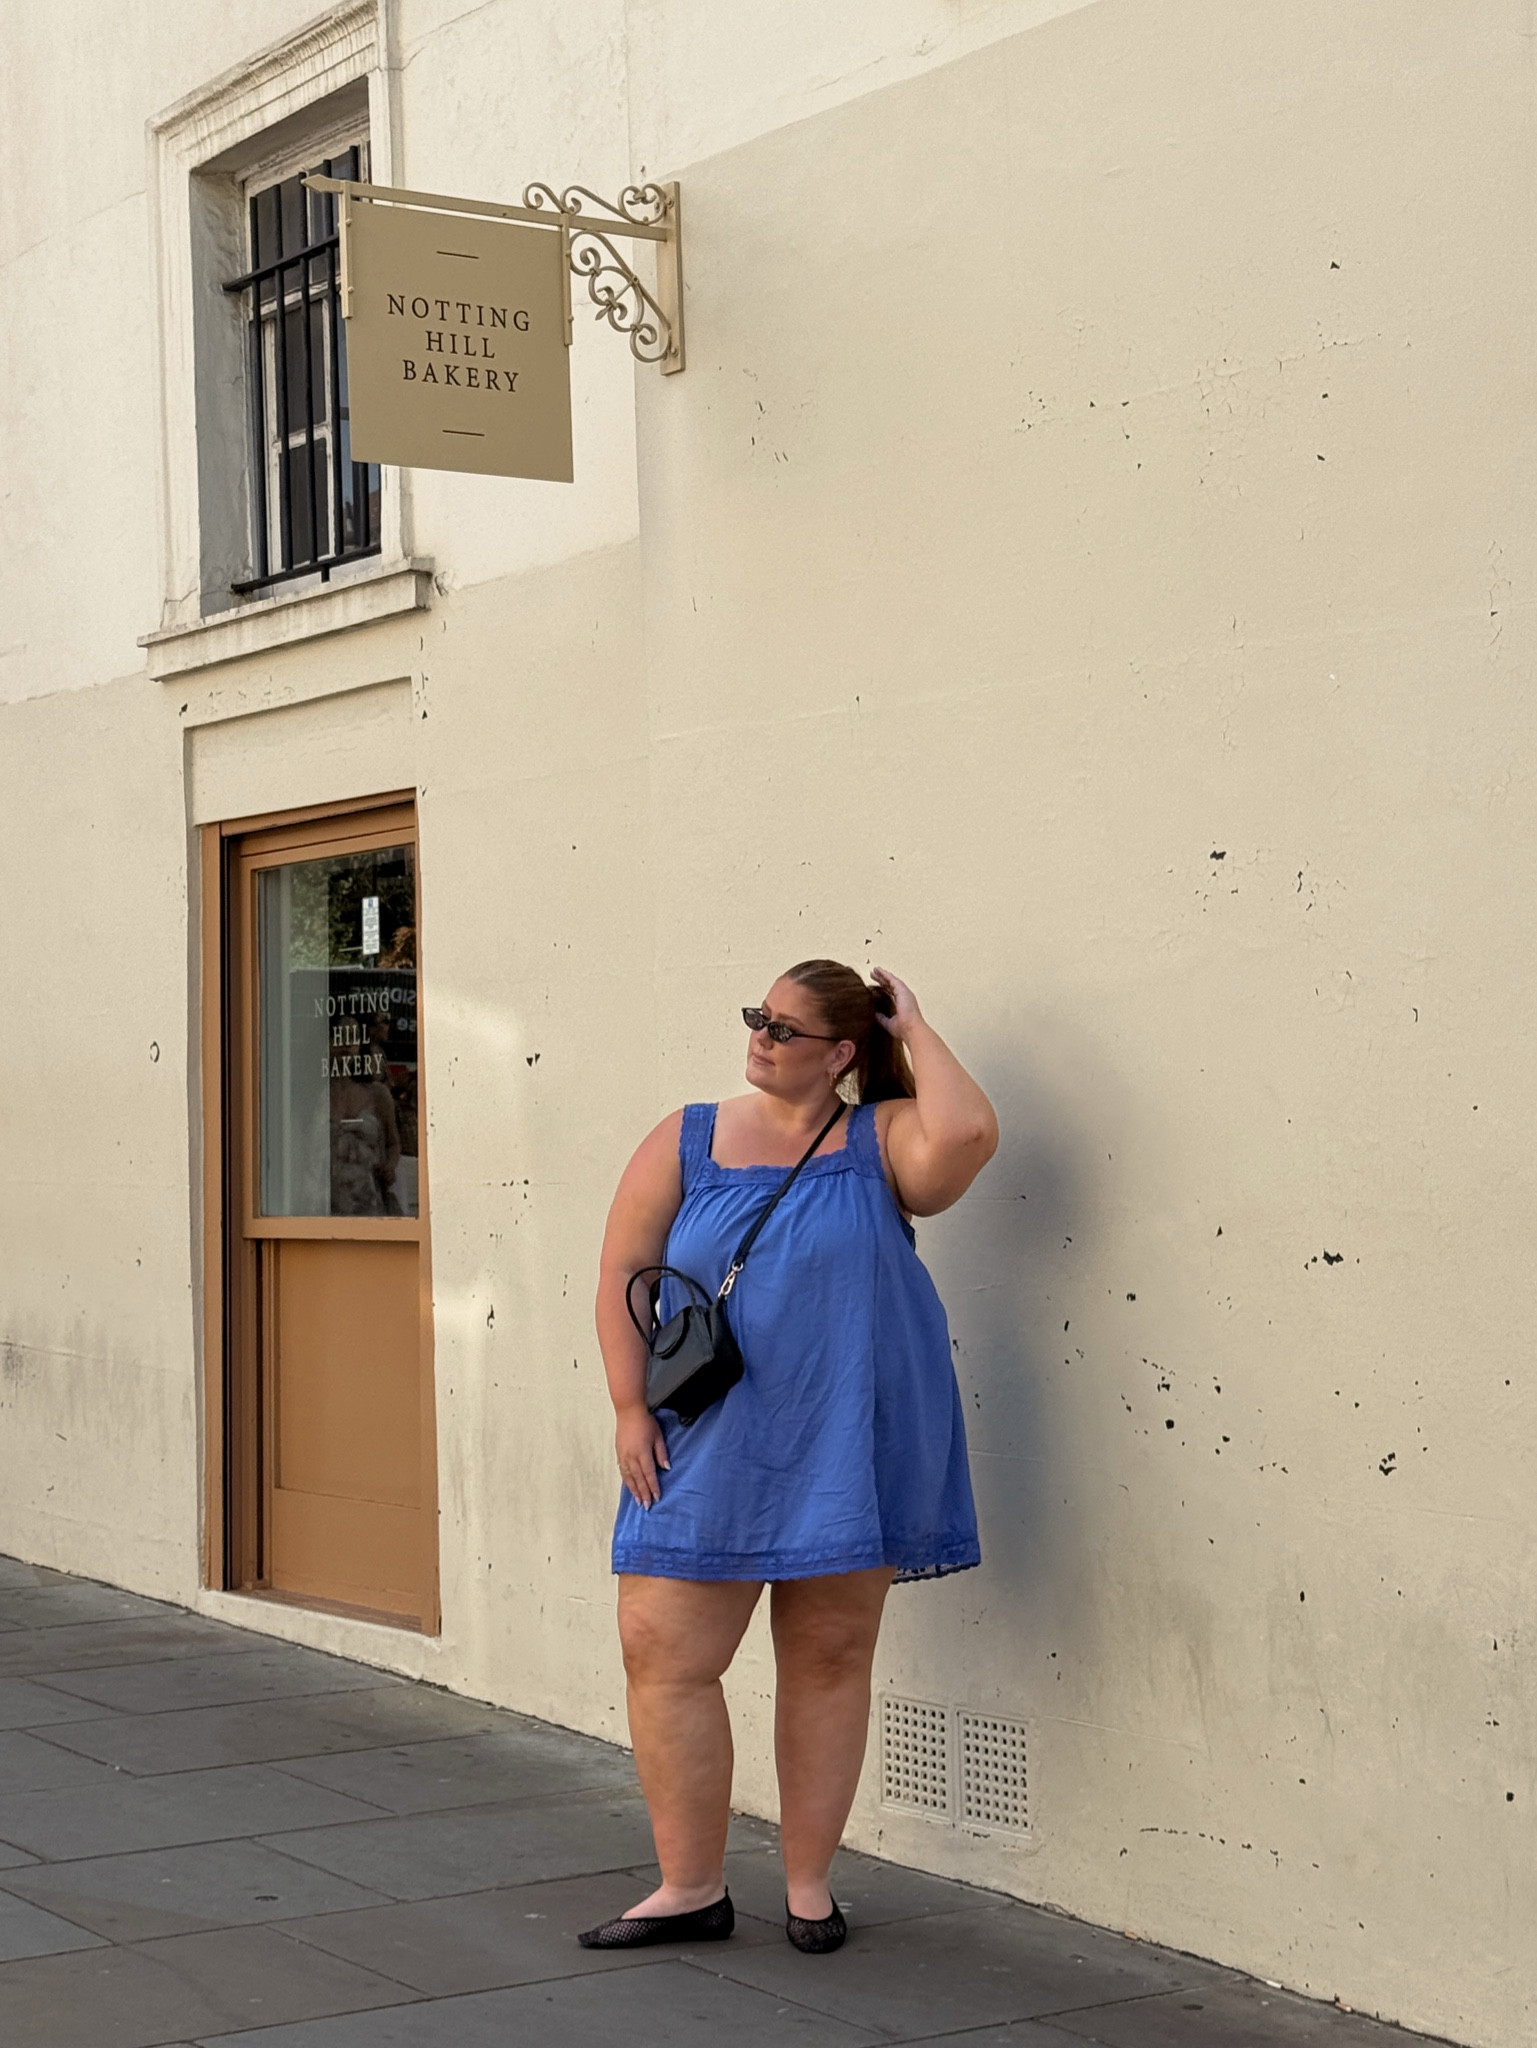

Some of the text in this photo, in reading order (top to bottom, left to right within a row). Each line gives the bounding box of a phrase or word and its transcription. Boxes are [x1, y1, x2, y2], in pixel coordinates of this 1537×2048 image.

[387, 294, 530, 331] NOTTING
[426, 331, 495, 358] HILL
[402, 359, 519, 392] BAKERY
[314, 991, 389, 1018] NOTTING
[332, 1023, 370, 1047] HILL
[321, 1053, 383, 1077] BAKERY
